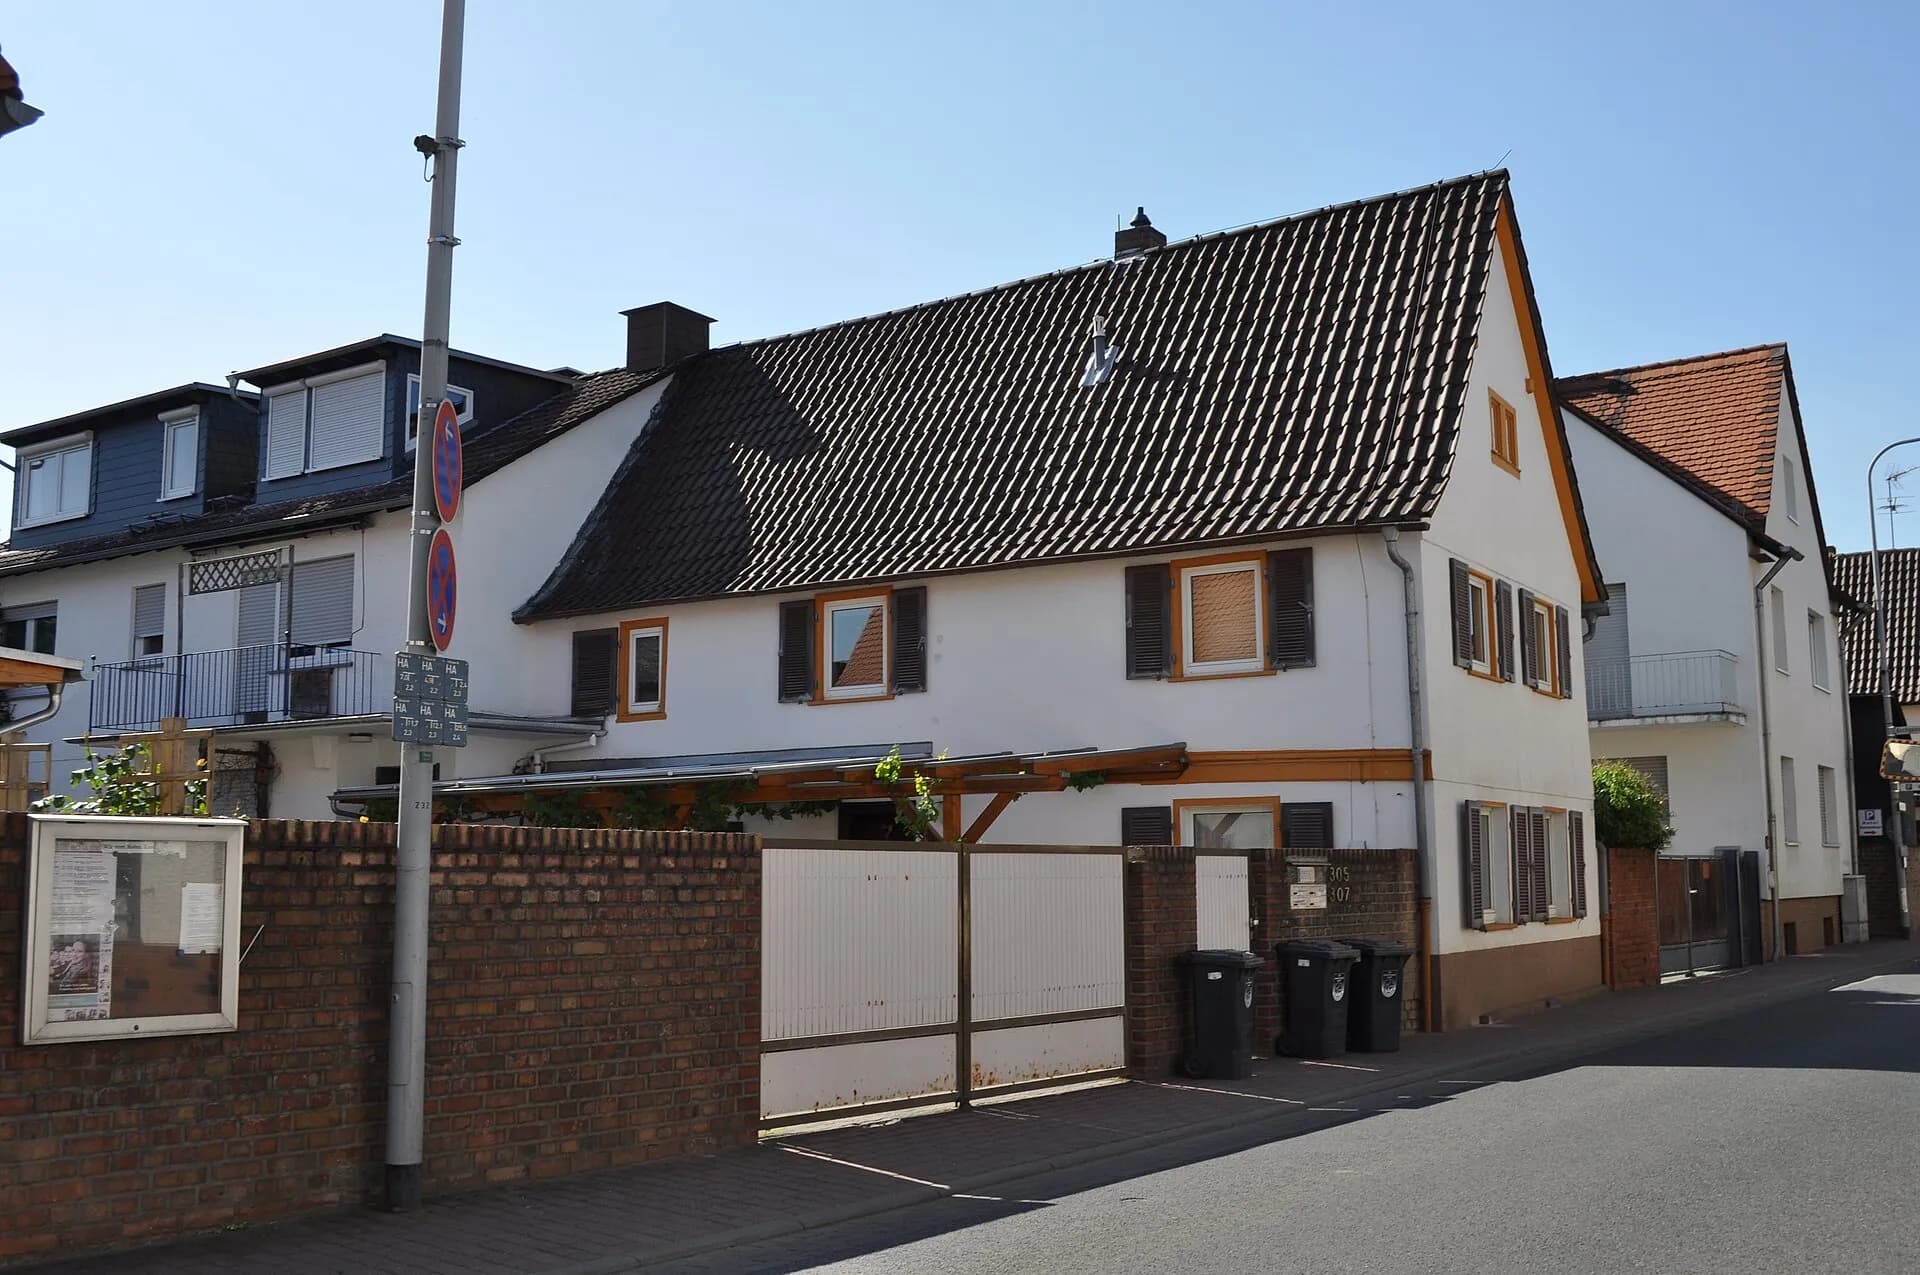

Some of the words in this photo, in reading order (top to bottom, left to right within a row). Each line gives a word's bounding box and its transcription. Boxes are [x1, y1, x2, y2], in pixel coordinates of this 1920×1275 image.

[397, 658, 409, 668] HA
[422, 661, 433, 671] HA
[446, 664, 457, 674] HA
[395, 702, 407, 712] HA
[420, 705, 432, 715] HA
[444, 708, 456, 718] HA
[1329, 867, 1350, 881] 305
[1329, 887, 1350, 901] 307
